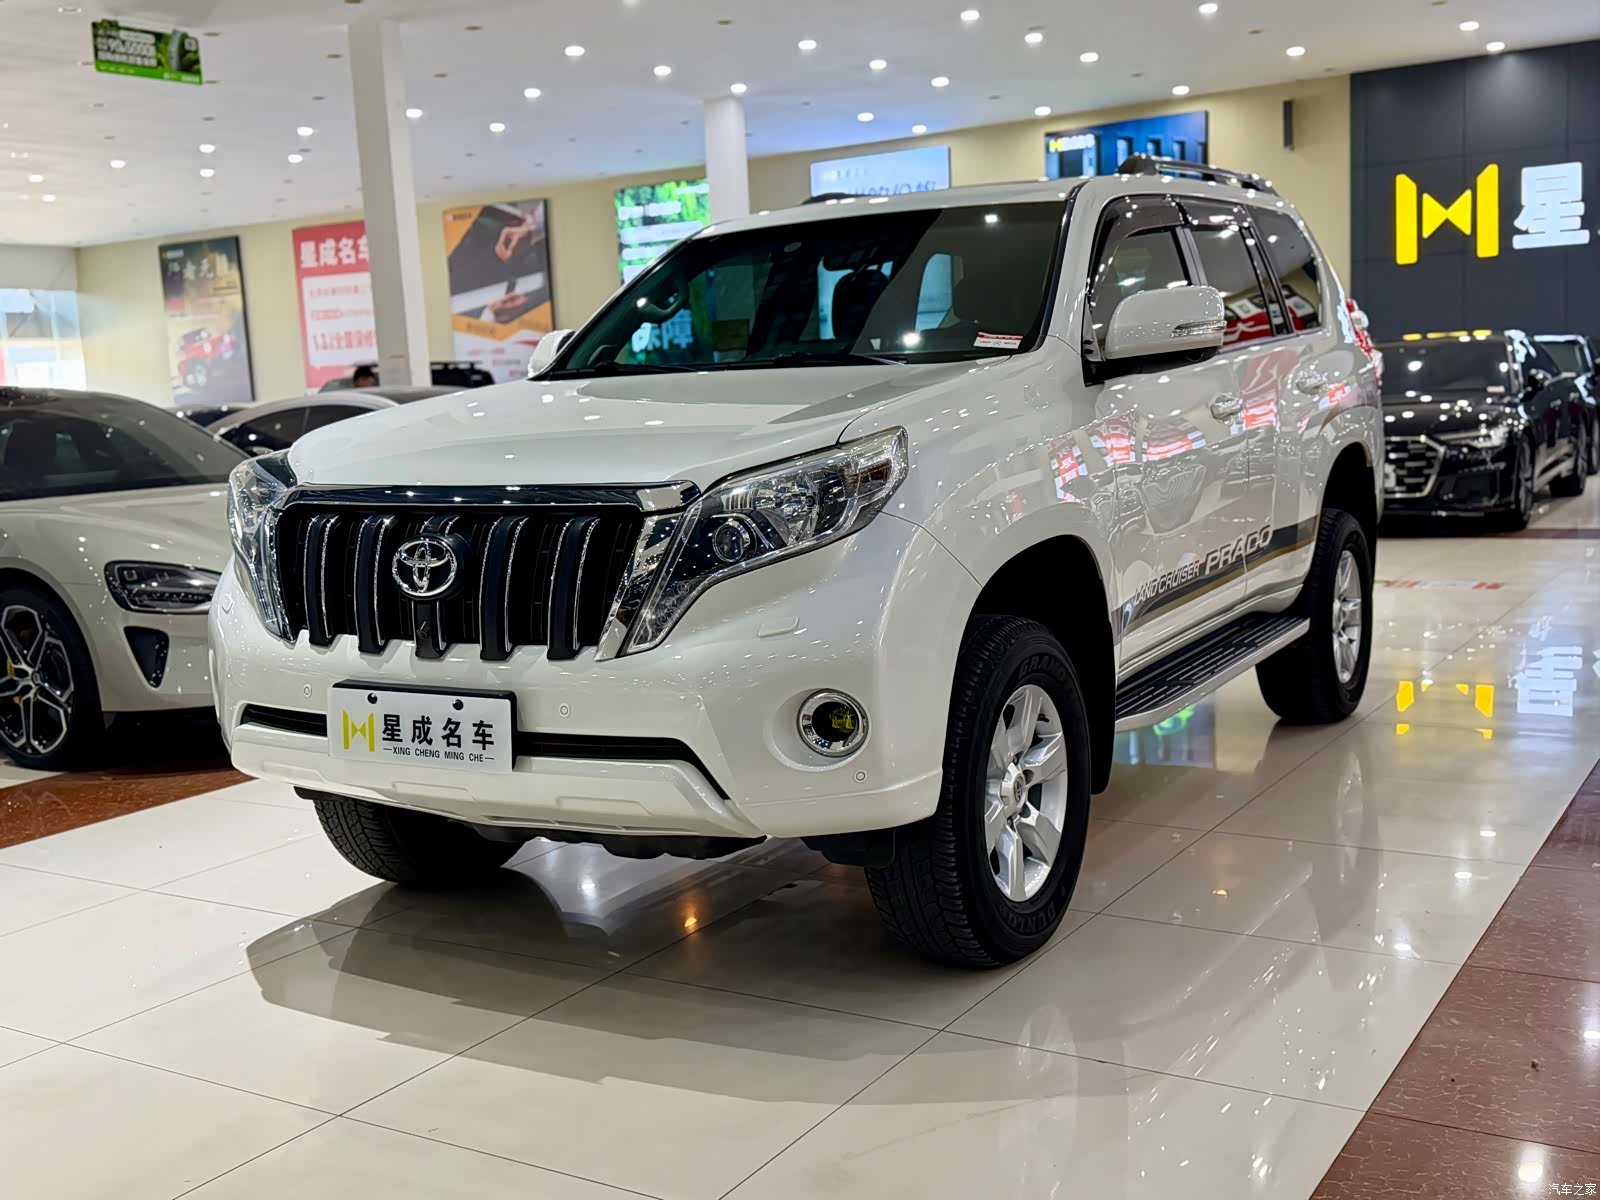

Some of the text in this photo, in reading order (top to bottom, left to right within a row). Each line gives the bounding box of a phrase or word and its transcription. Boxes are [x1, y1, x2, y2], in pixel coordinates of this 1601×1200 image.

[1157, 559, 1201, 594] CRUISER
[1204, 524, 1274, 576] PRADO
[381, 713, 496, 751] 星成名车
[392, 746, 484, 763] XING CHENG MING CHE
